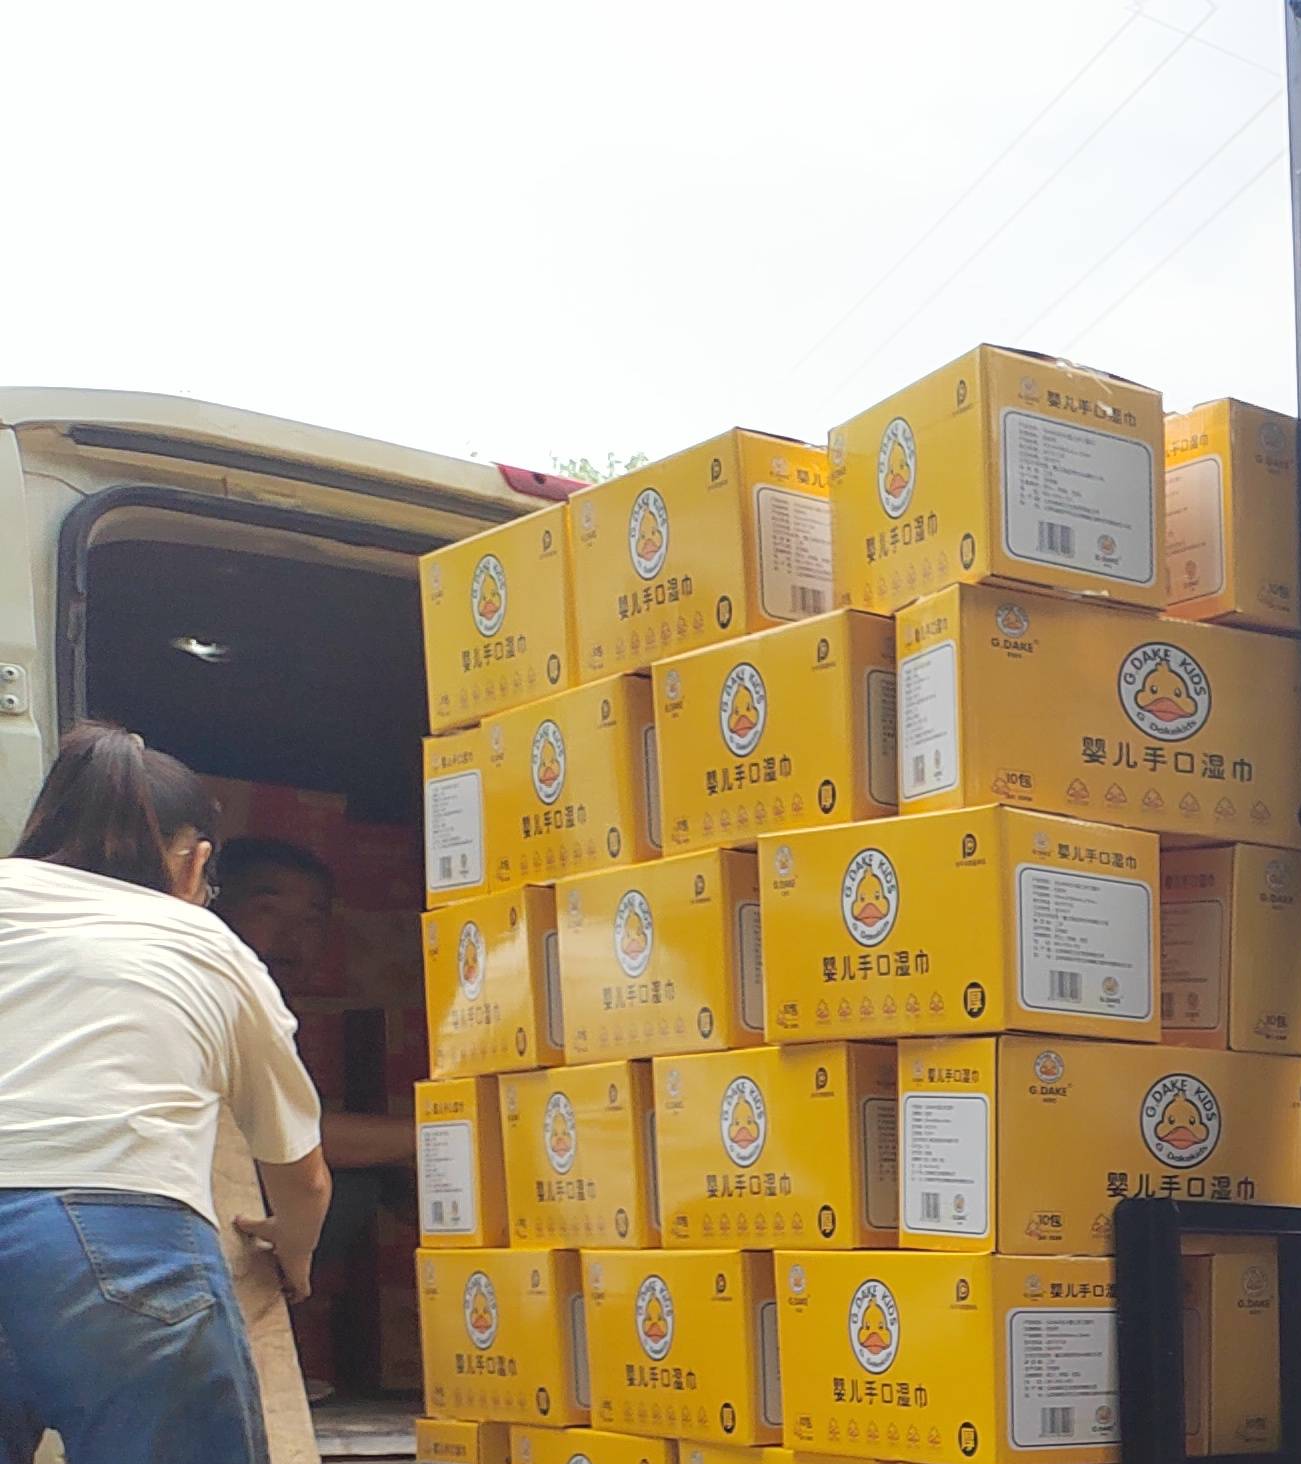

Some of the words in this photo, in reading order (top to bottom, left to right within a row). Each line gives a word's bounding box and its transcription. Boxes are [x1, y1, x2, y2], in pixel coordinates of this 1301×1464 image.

[1179, 657, 1207, 697] KIDS
[1082, 734, 1254, 783] 婴儿手口湿巾
[705, 754, 793, 796] 婴儿手口湿巾
[1057, 842, 1138, 869] 婴儿手口湿巾
[822, 950, 930, 982] 婴儿手口湿巾
[1194, 1087, 1216, 1122] KIDS
[705, 1173, 792, 1197] 婴儿手口湿巾
[1107, 1172, 1256, 1200] 婴儿手口湿巾
[833, 1377, 929, 1408] 婴儿手口湿巾
